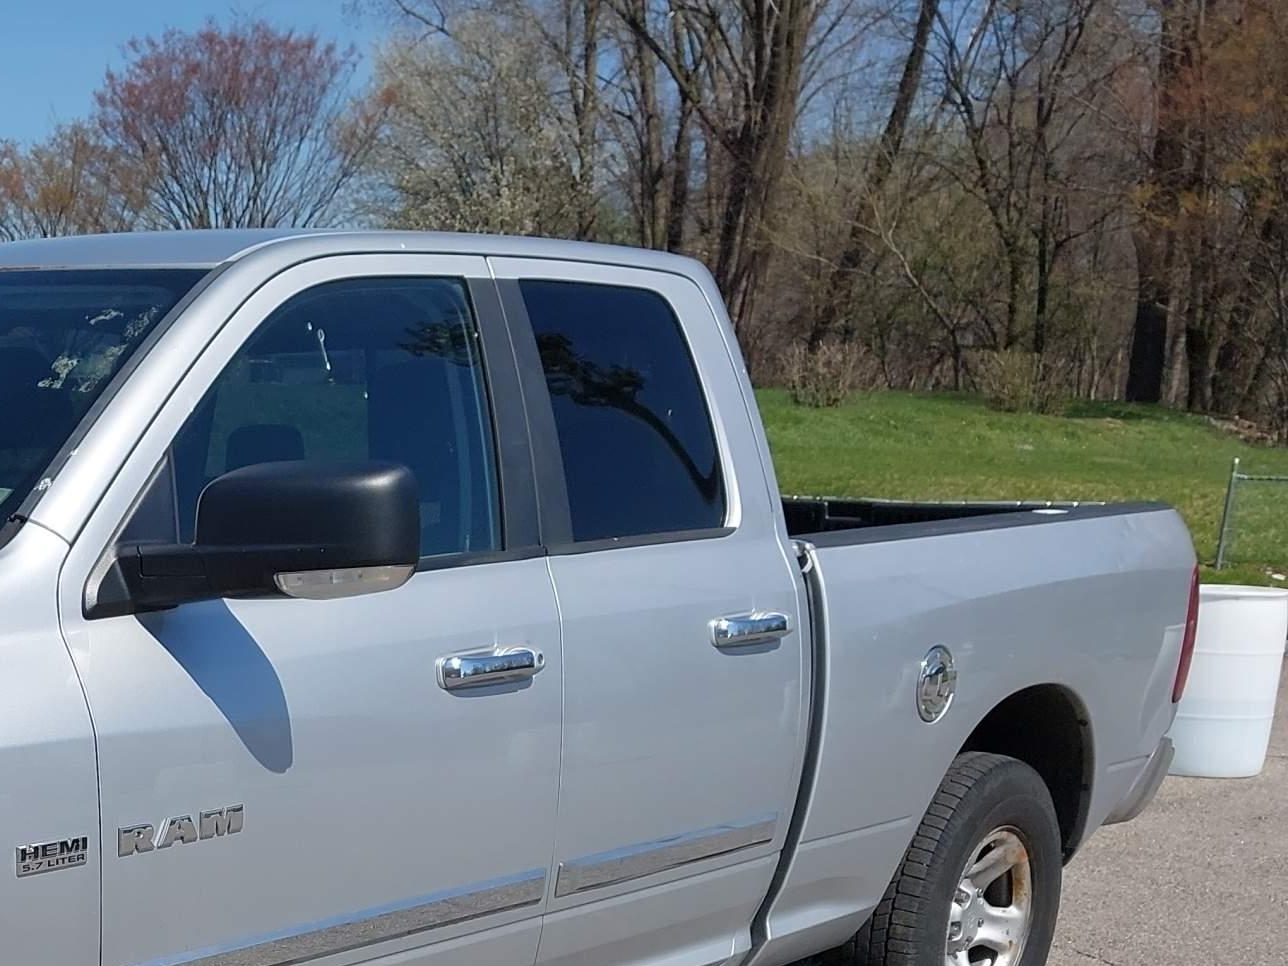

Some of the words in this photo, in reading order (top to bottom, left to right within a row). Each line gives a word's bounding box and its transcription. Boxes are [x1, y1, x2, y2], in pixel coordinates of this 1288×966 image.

[118, 802, 244, 857] RAM
[19, 836, 88, 863] HEMI
[21, 861, 45, 873] 5.7
[47, 853, 86, 868] LITER
